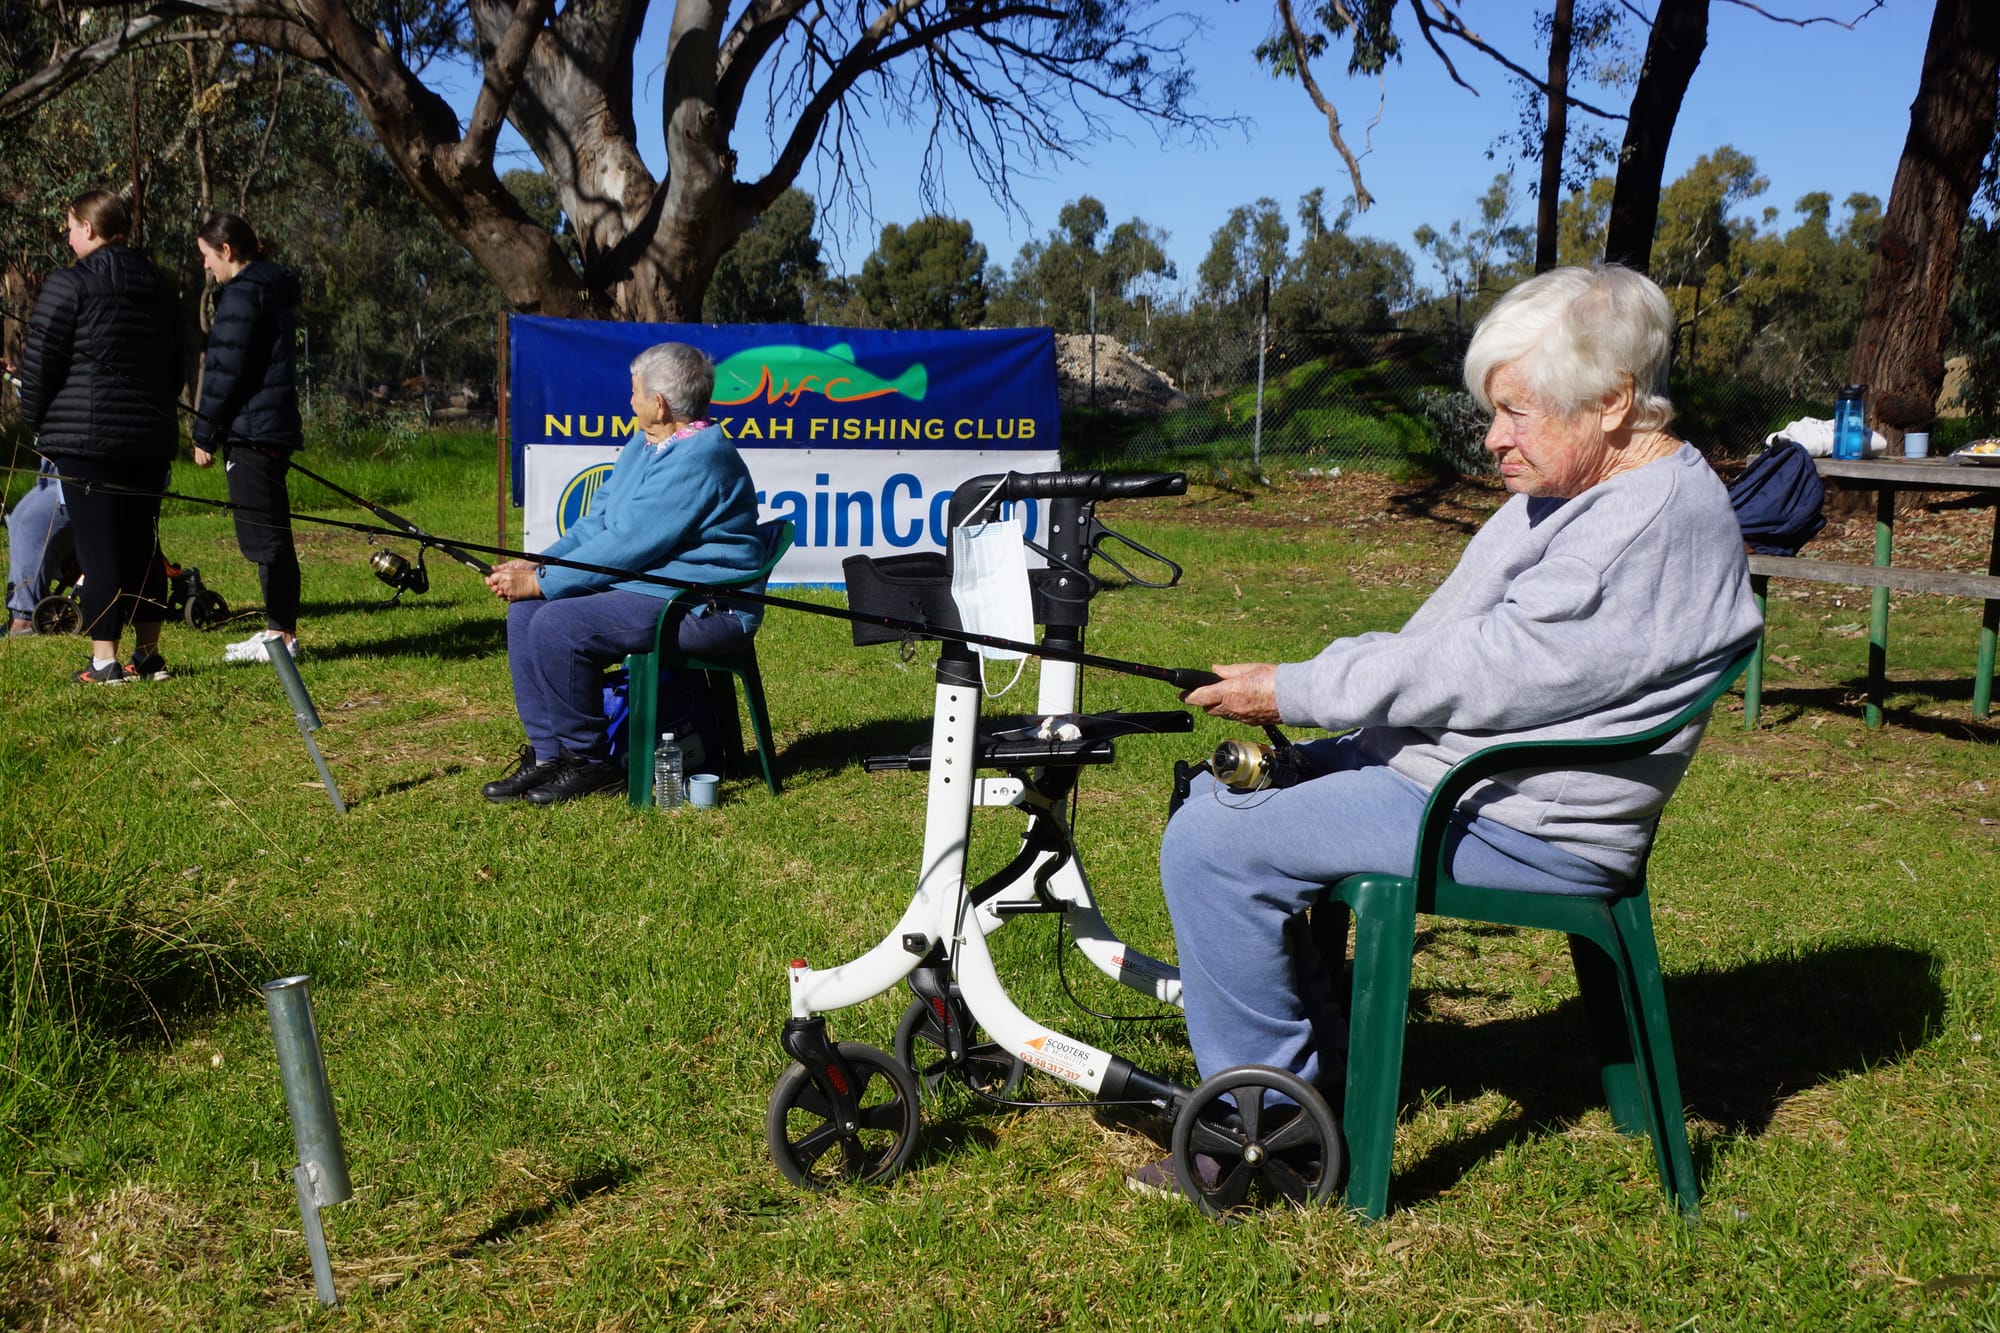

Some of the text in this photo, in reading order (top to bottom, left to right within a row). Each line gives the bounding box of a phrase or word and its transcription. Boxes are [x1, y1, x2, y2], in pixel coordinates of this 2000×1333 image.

[544, 414, 1036, 440] NUMKAH FISHING CLUB
[756, 472, 1038, 547] ainCo
[1046, 1038, 1090, 1061] SCOOTERS
[1047, 1062, 1064, 1074] 317
[1064, 1069, 1081, 1081] 317
